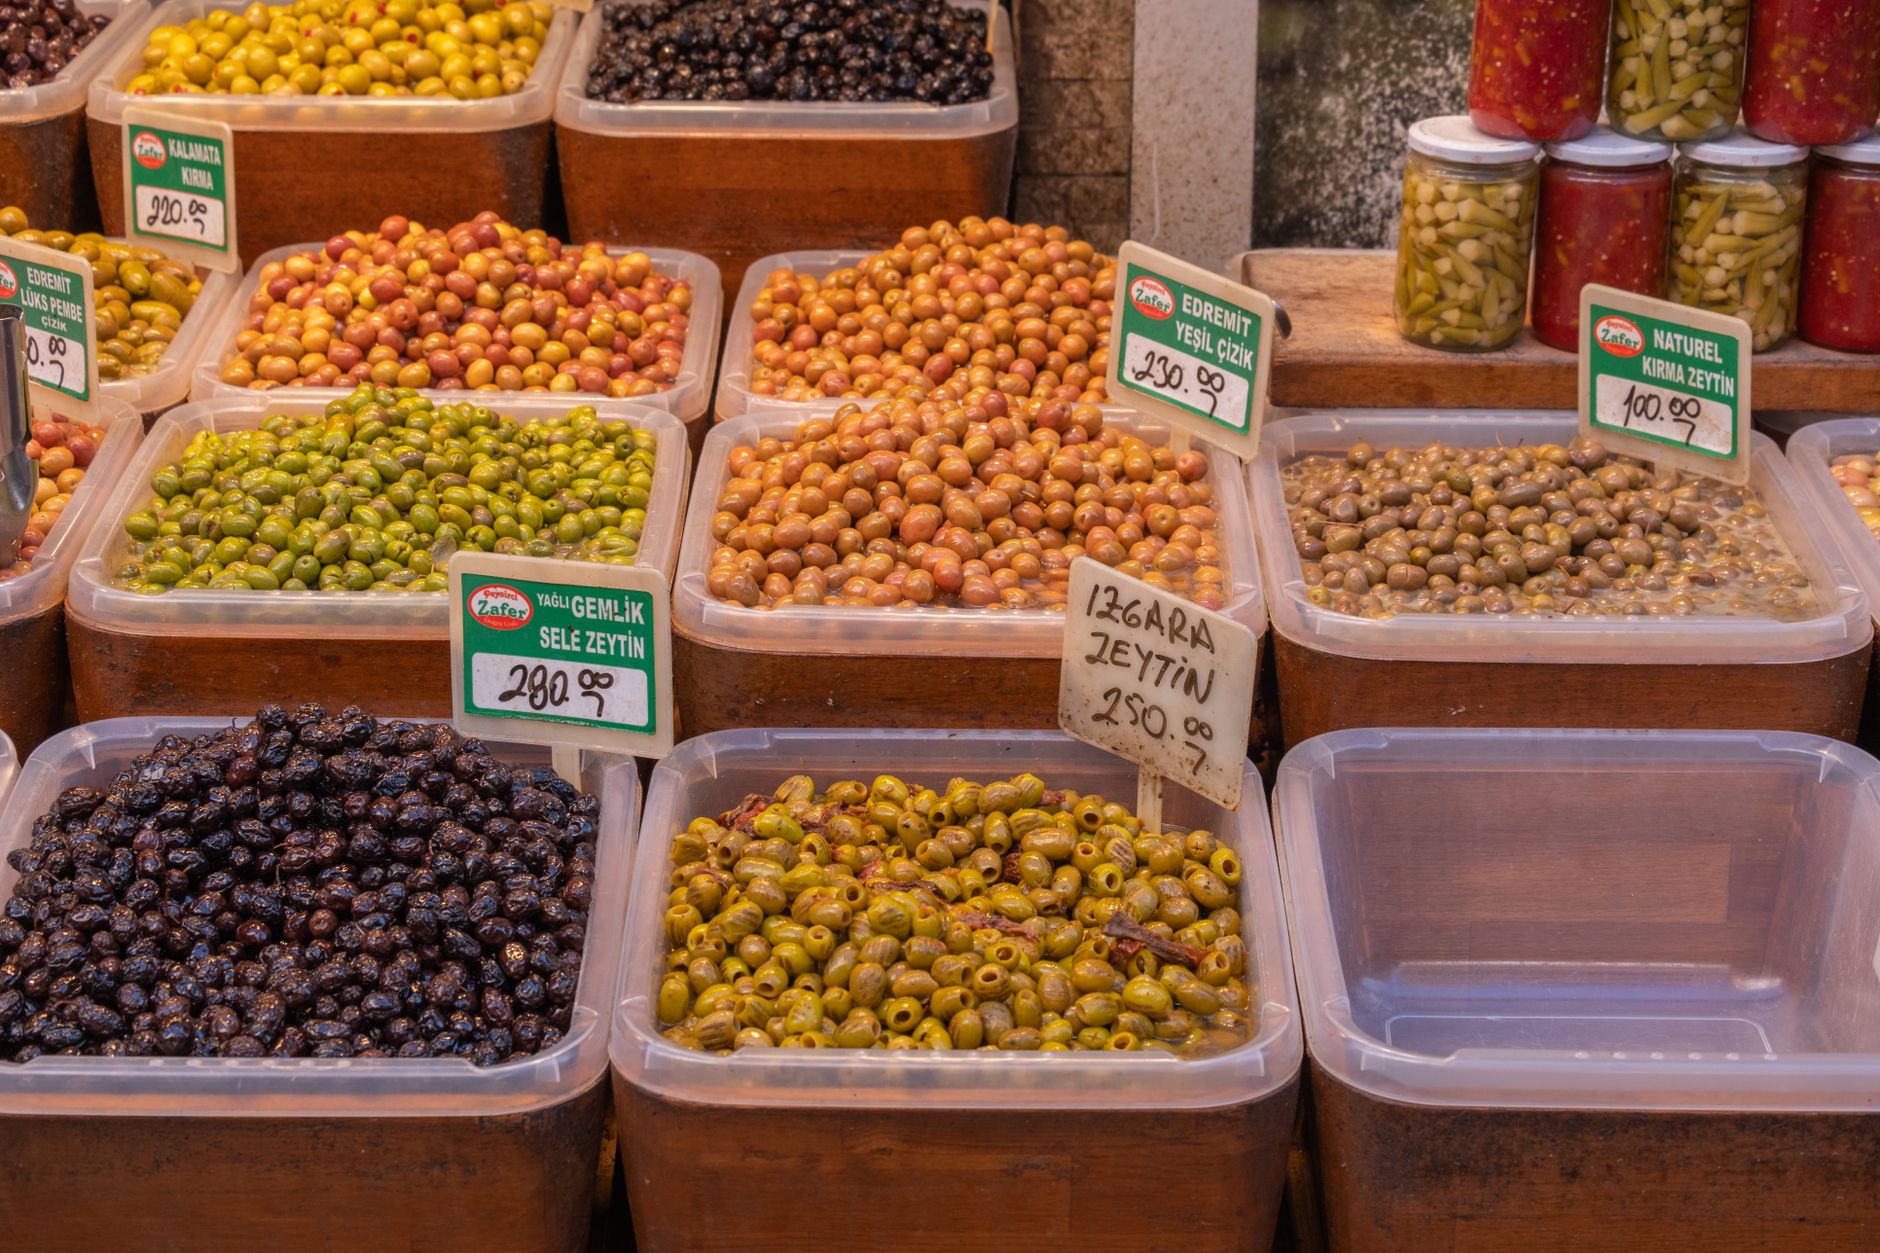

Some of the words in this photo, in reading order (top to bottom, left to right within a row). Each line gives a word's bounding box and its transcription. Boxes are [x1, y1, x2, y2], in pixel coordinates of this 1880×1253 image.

[168, 139, 221, 166] KALAMATA
[181, 166, 214, 190] KIRMA
[27, 267, 71, 295] EDREMİT
[20, 287, 48, 311] LÜKS
[50, 297, 83, 323] PEMBE
[1135, 288, 1170, 313] Zafer
[1182, 293, 1252, 338] EDREMİT
[41, 316, 67, 332] ÇİZİK
[1601, 328, 1639, 349] Zafer
[1176, 320, 1213, 353] YEŞİL
[1217, 338, 1253, 371] ÇİZİK
[1653, 328, 1723, 364] NATUREL
[1642, 356, 1685, 384] KIRMA
[1688, 367, 1734, 397] ZEYTİN
[478, 600, 526, 619] Zafer
[536, 592, 569, 609] YAĞLI
[571, 594, 644, 625] GEMLİK
[1086, 583, 1215, 654] IZGARA
[540, 626, 581, 651] SELE
[586, 629, 644, 659] ZEYTİN
[1085, 631, 1215, 705] ZEYTİN
